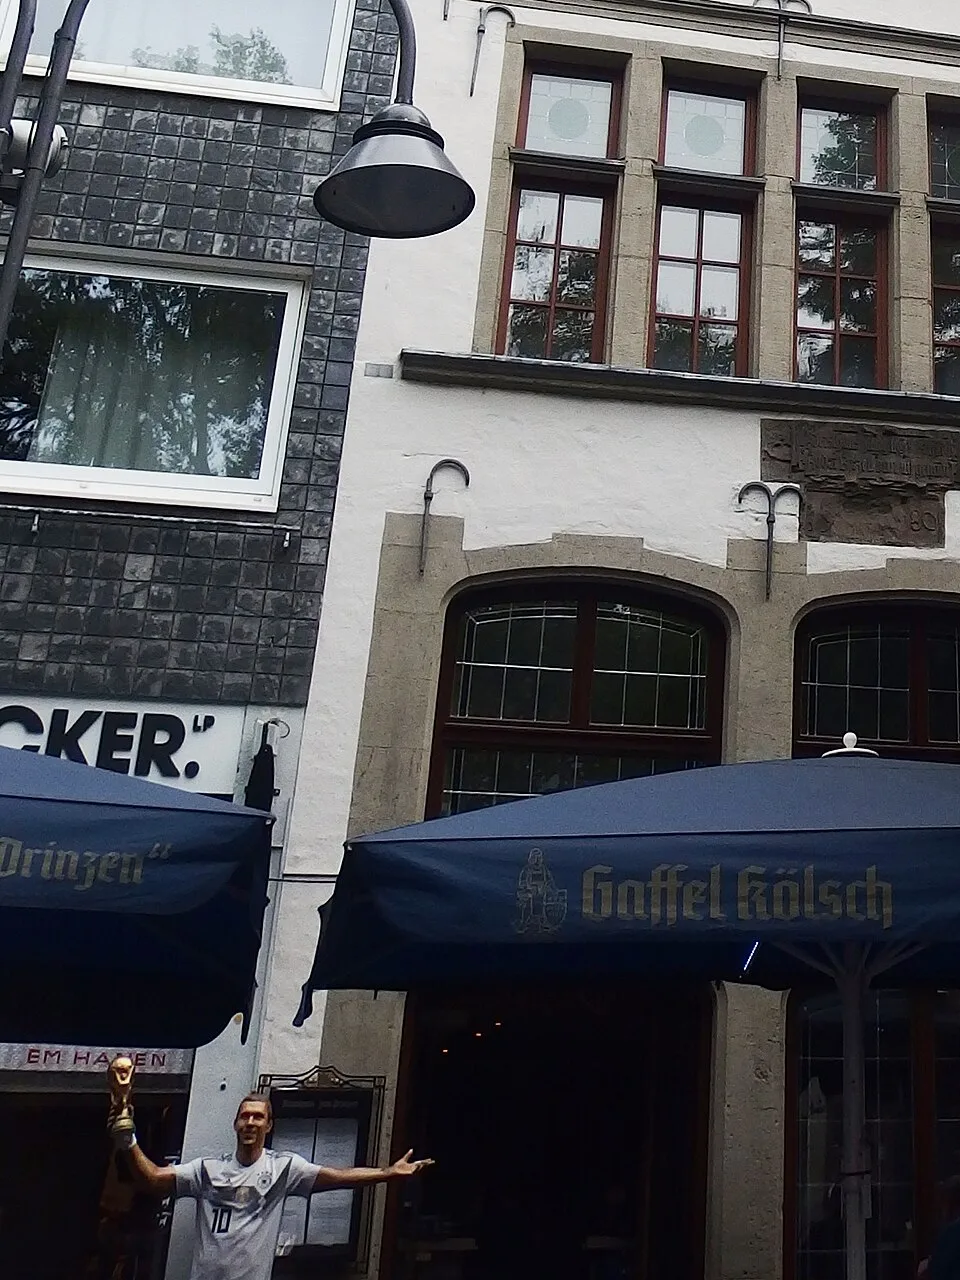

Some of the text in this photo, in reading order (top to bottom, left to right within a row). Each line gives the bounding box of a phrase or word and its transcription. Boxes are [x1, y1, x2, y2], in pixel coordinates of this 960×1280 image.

[581, 863, 894, 930] Gaffel Kölsch
[211, 1207, 233, 1234] 10
